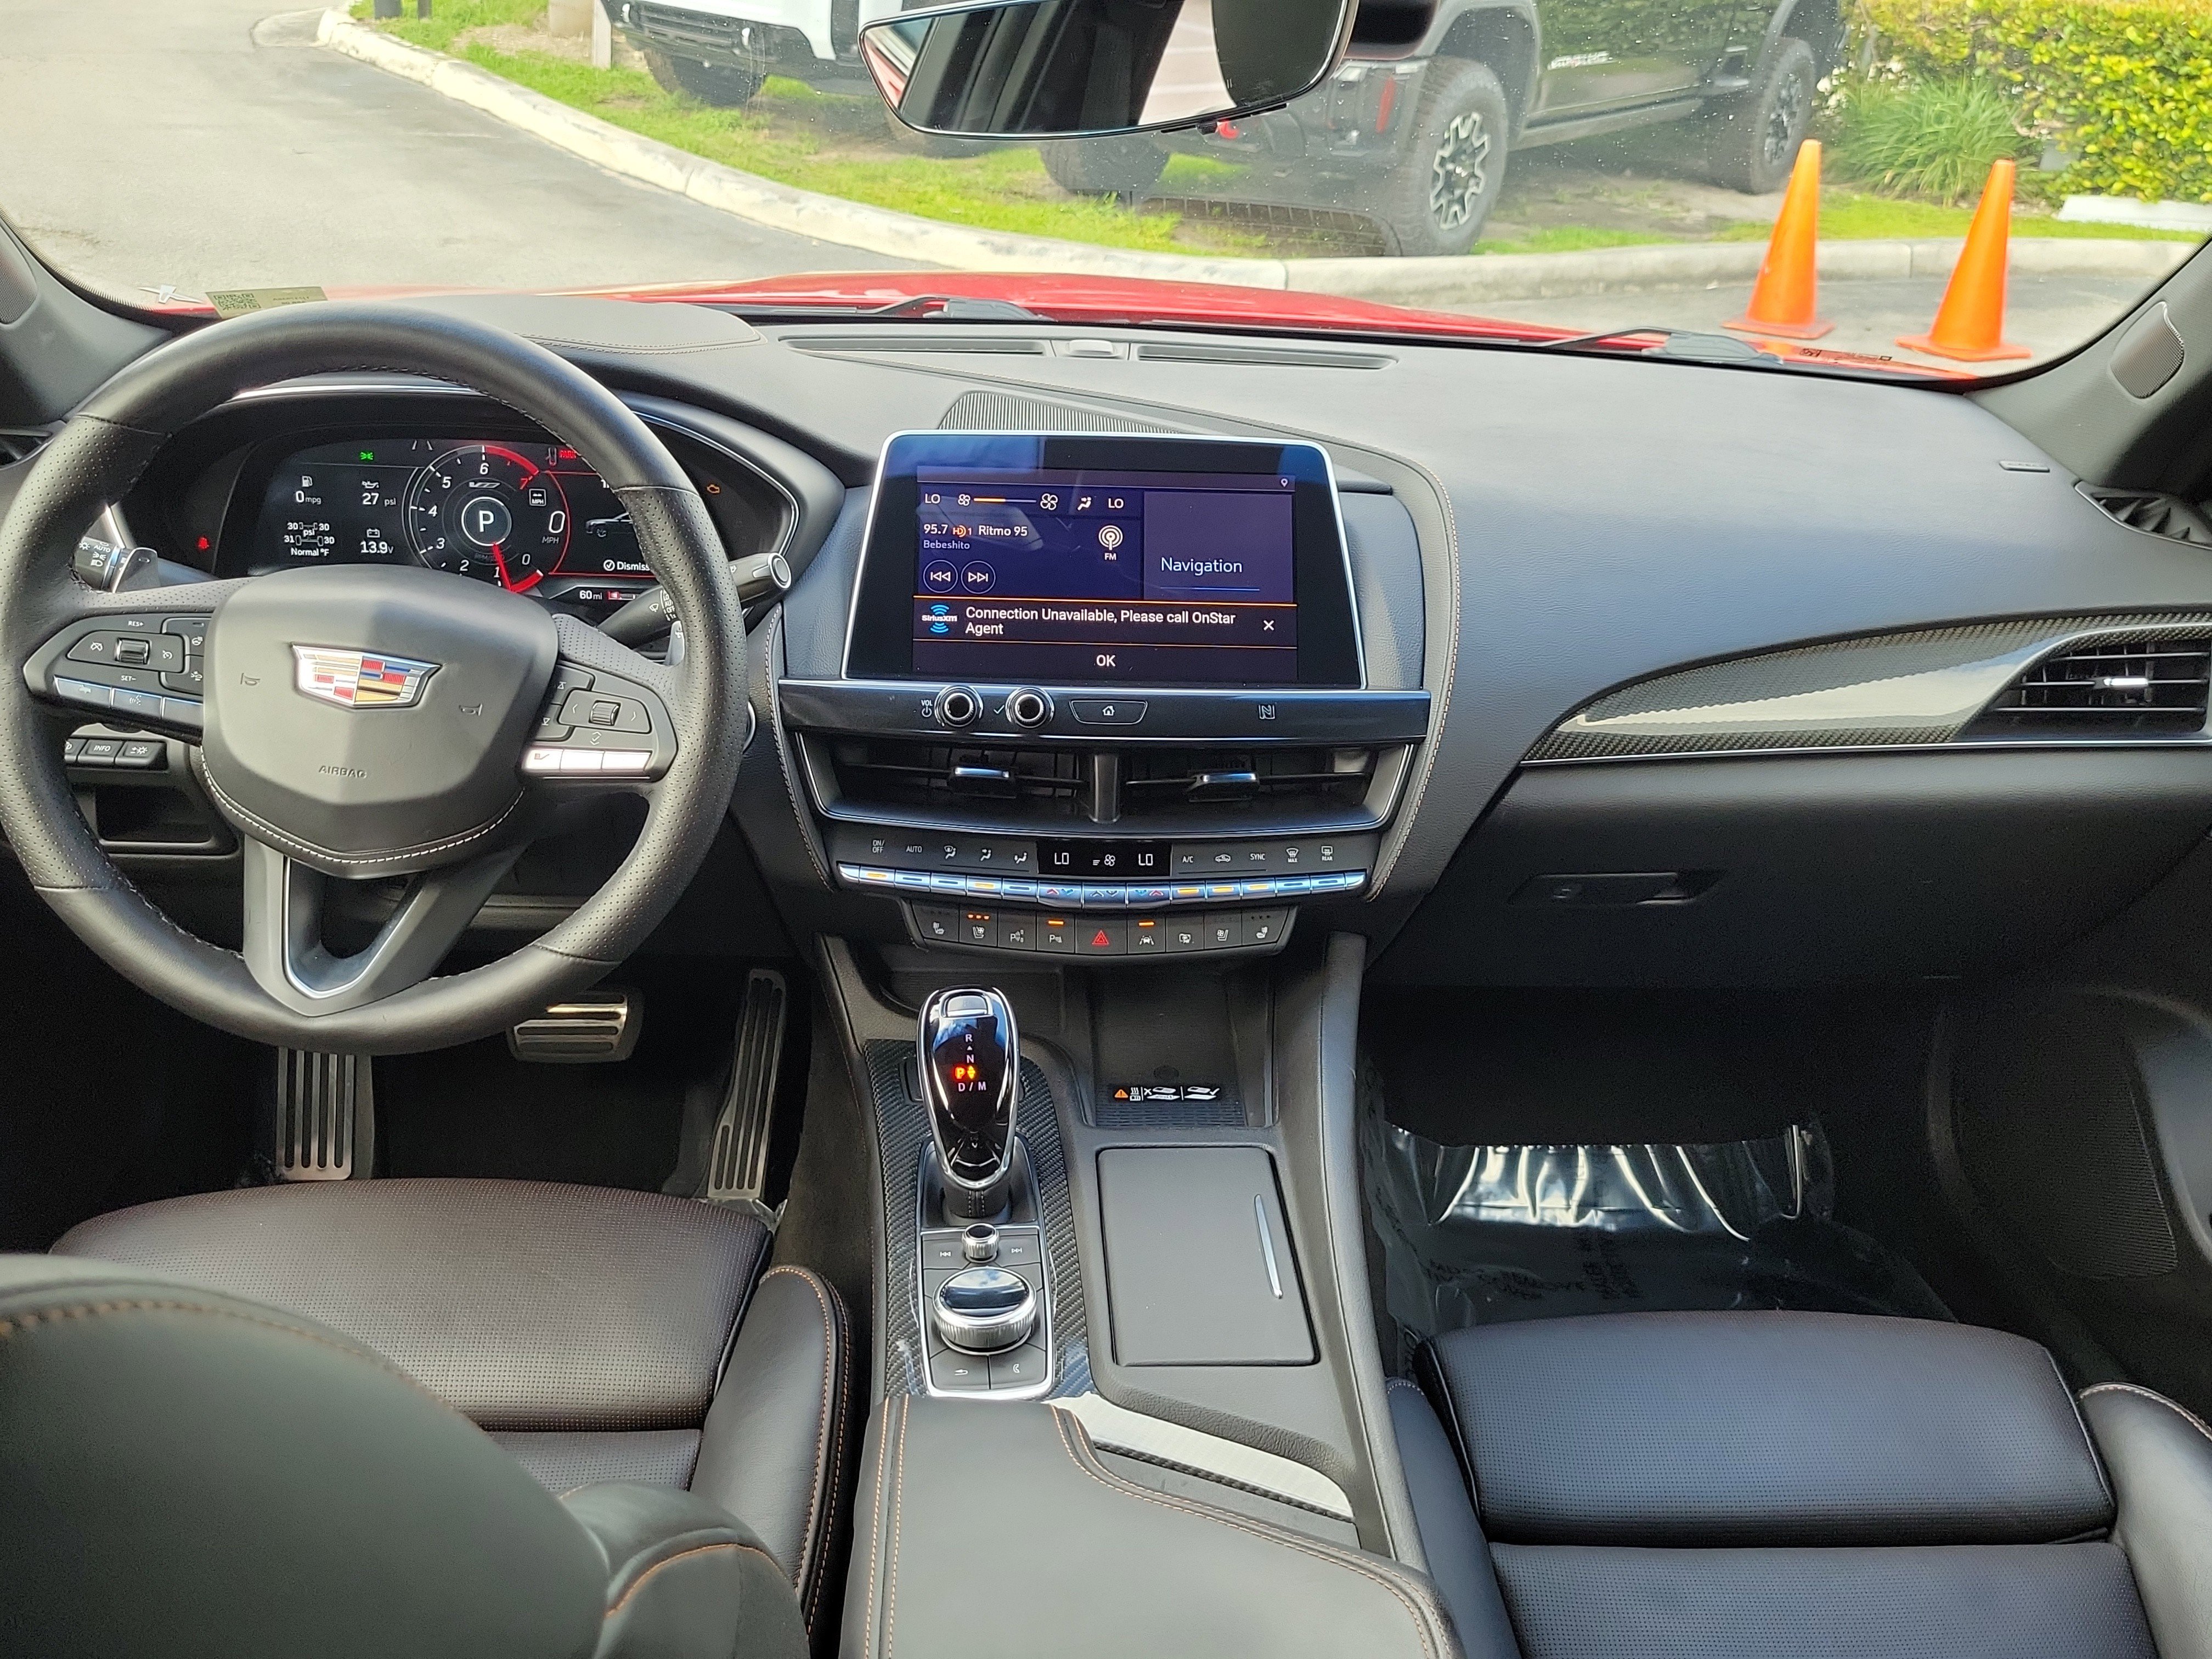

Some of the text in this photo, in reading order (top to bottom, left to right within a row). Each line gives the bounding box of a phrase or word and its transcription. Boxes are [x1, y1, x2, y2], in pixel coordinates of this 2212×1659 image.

[479, 463, 489, 475] 6
[442, 477, 452, 488] 5
[520, 478, 531, 490] 7
[362, 493, 379, 505] 27
[924, 493, 941, 504] LO
[1108, 498, 1124, 509] LO
[428, 505, 438, 517] 4
[287, 522, 330, 532] 30 30
[479, 510, 494, 532] P
[549, 511, 566, 533] 0
[923, 524, 948, 534] 95.7
[978, 525, 1011, 536] Ritmo
[1014, 526, 1028, 537] 95
[284, 535, 335, 544] 31 30
[436, 537, 445, 549] 3
[923, 540, 970, 550] Bebeshito
[93, 545, 111, 553] AUTO
[290, 547, 319, 556] Normal
[522, 554, 531, 566] 0
[1104, 552, 1117, 561] FM
[460, 560, 469, 571] 2
[617, 561, 650, 571] Dismiss
[1161, 557, 1243, 576] Navigation
[966, 607, 1236, 624] Connection Unavailable, Please call OnStar
[965, 623, 1003, 636] Agent
[1096, 655, 1116, 667] OK
[319, 765, 367, 779] AIRBAG
[1054, 853, 1069, 865] LO
[1138, 854, 1153, 866] LO
[1182, 855, 1194, 864] A/C
[965, 1034, 973, 1043] R
[967, 1054, 974, 1063] N
[955, 1067, 965, 1079] P
